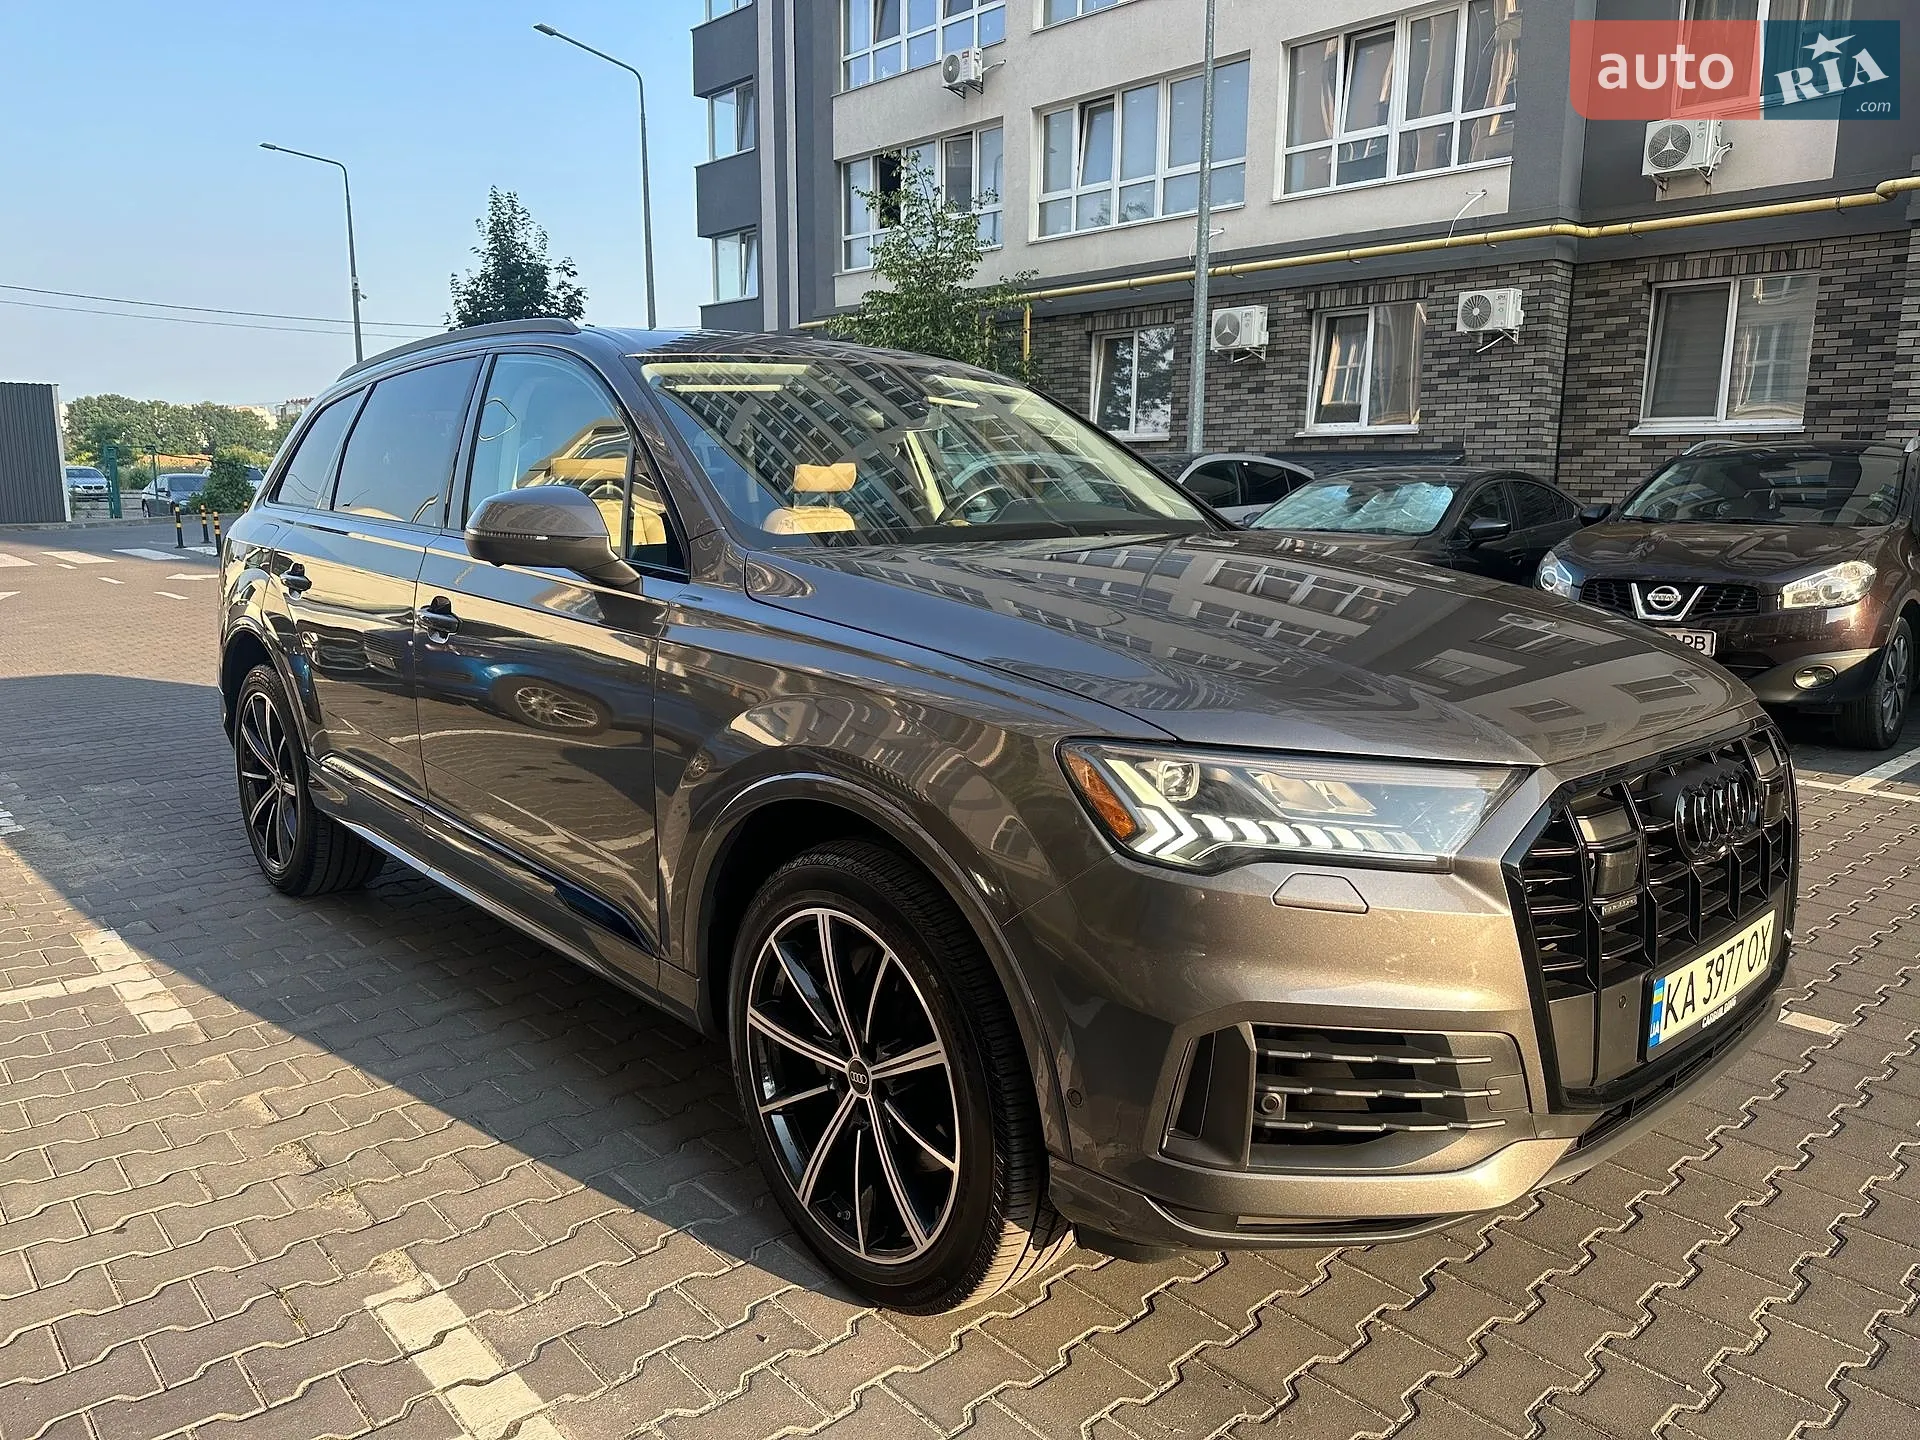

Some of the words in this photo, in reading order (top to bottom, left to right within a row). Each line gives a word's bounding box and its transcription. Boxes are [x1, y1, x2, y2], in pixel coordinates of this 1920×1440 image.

[1664, 970, 1696, 1031] KA
[1702, 938, 1745, 1005] 3977
[1747, 919, 1772, 973] OX
[1649, 1020, 1660, 1039] UA
